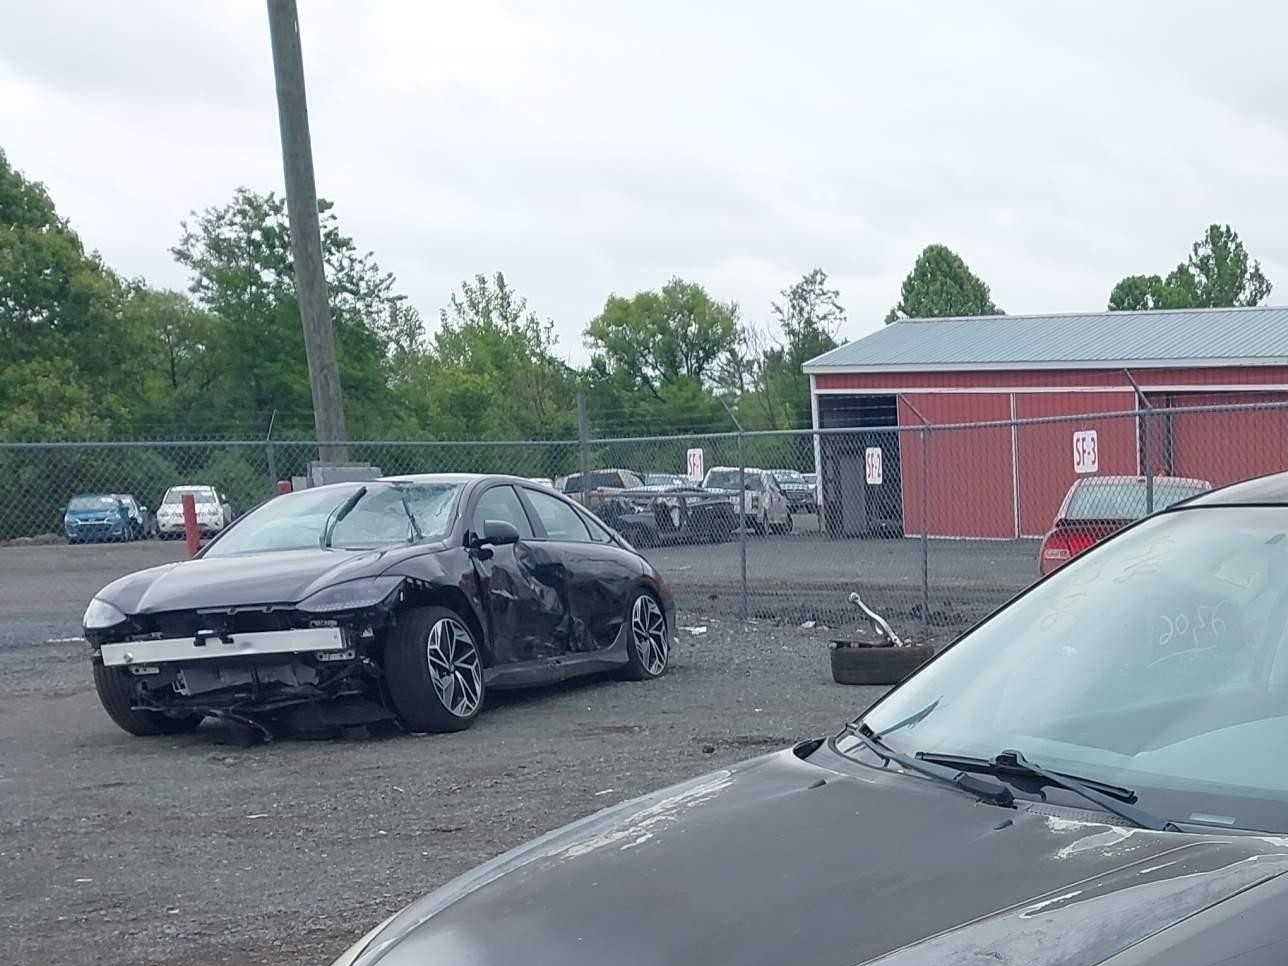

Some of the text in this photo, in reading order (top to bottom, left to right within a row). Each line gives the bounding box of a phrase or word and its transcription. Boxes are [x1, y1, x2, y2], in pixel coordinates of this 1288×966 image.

[1076, 437, 1096, 466] SF-3
[689, 453, 702, 477] SF-1
[867, 453, 881, 479] SF-2
